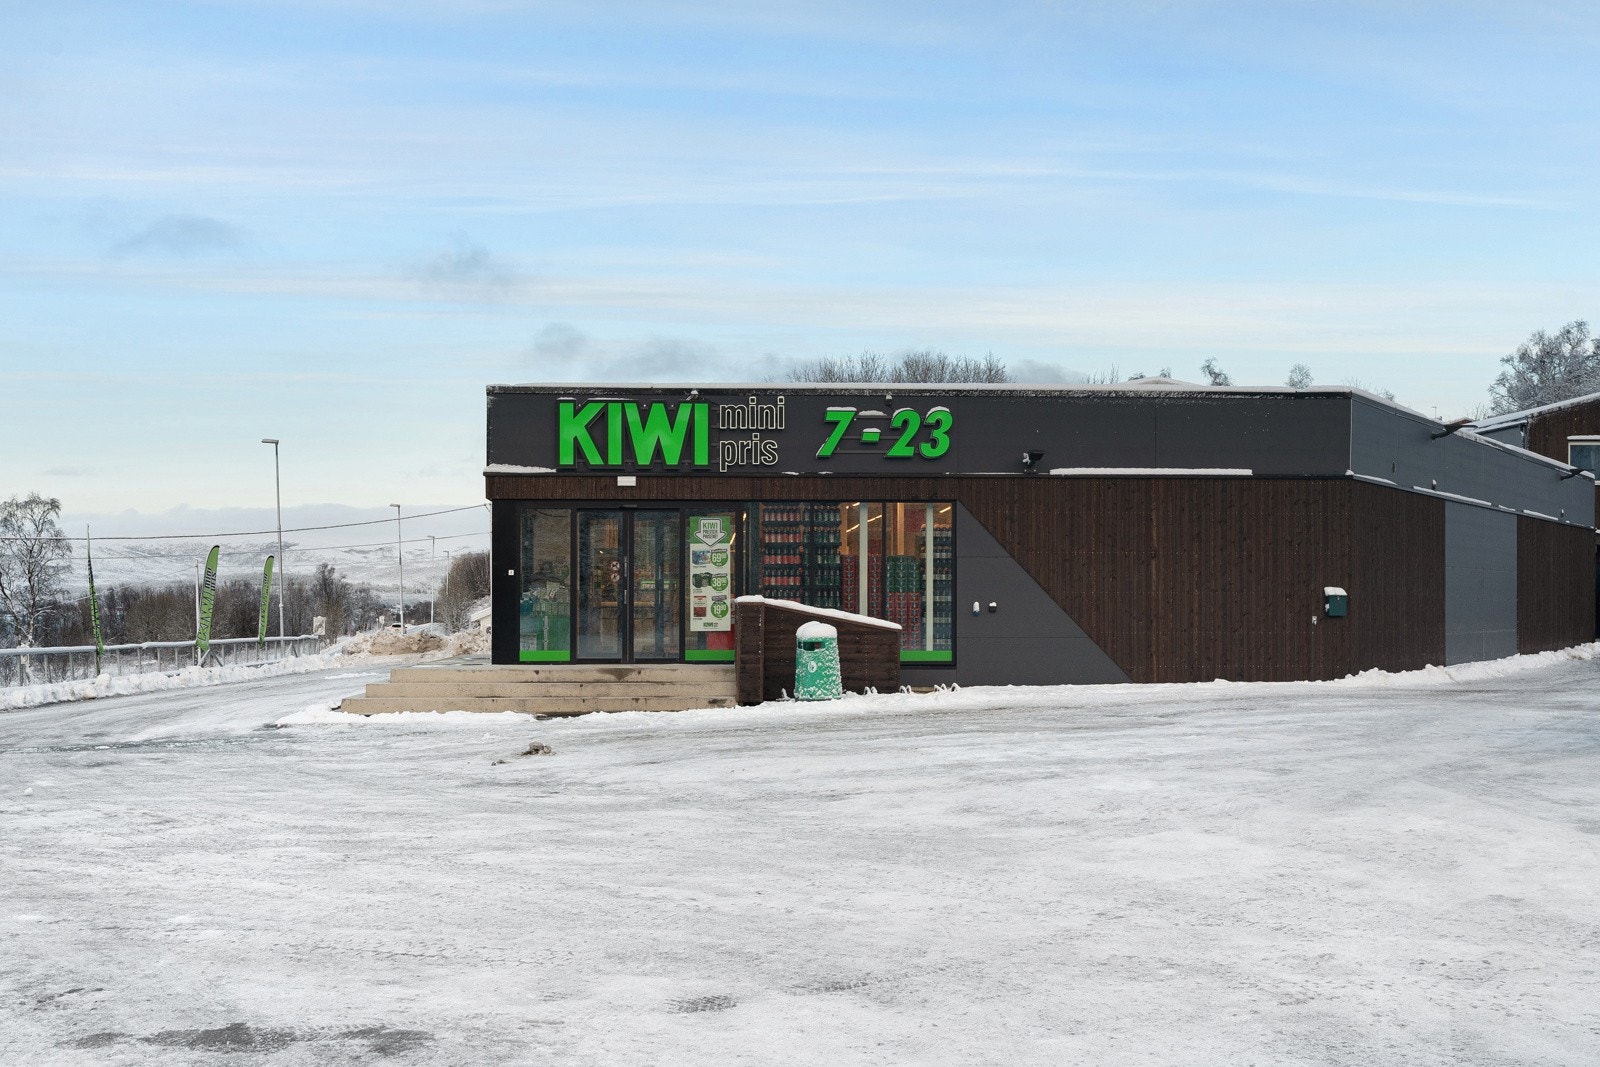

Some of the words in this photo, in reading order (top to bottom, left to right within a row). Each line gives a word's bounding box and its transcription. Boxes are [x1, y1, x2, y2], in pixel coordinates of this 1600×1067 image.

[719, 395, 786, 430] mini
[558, 401, 710, 466] KIWI
[719, 432, 779, 473] pris
[204, 567, 212, 589] mini
